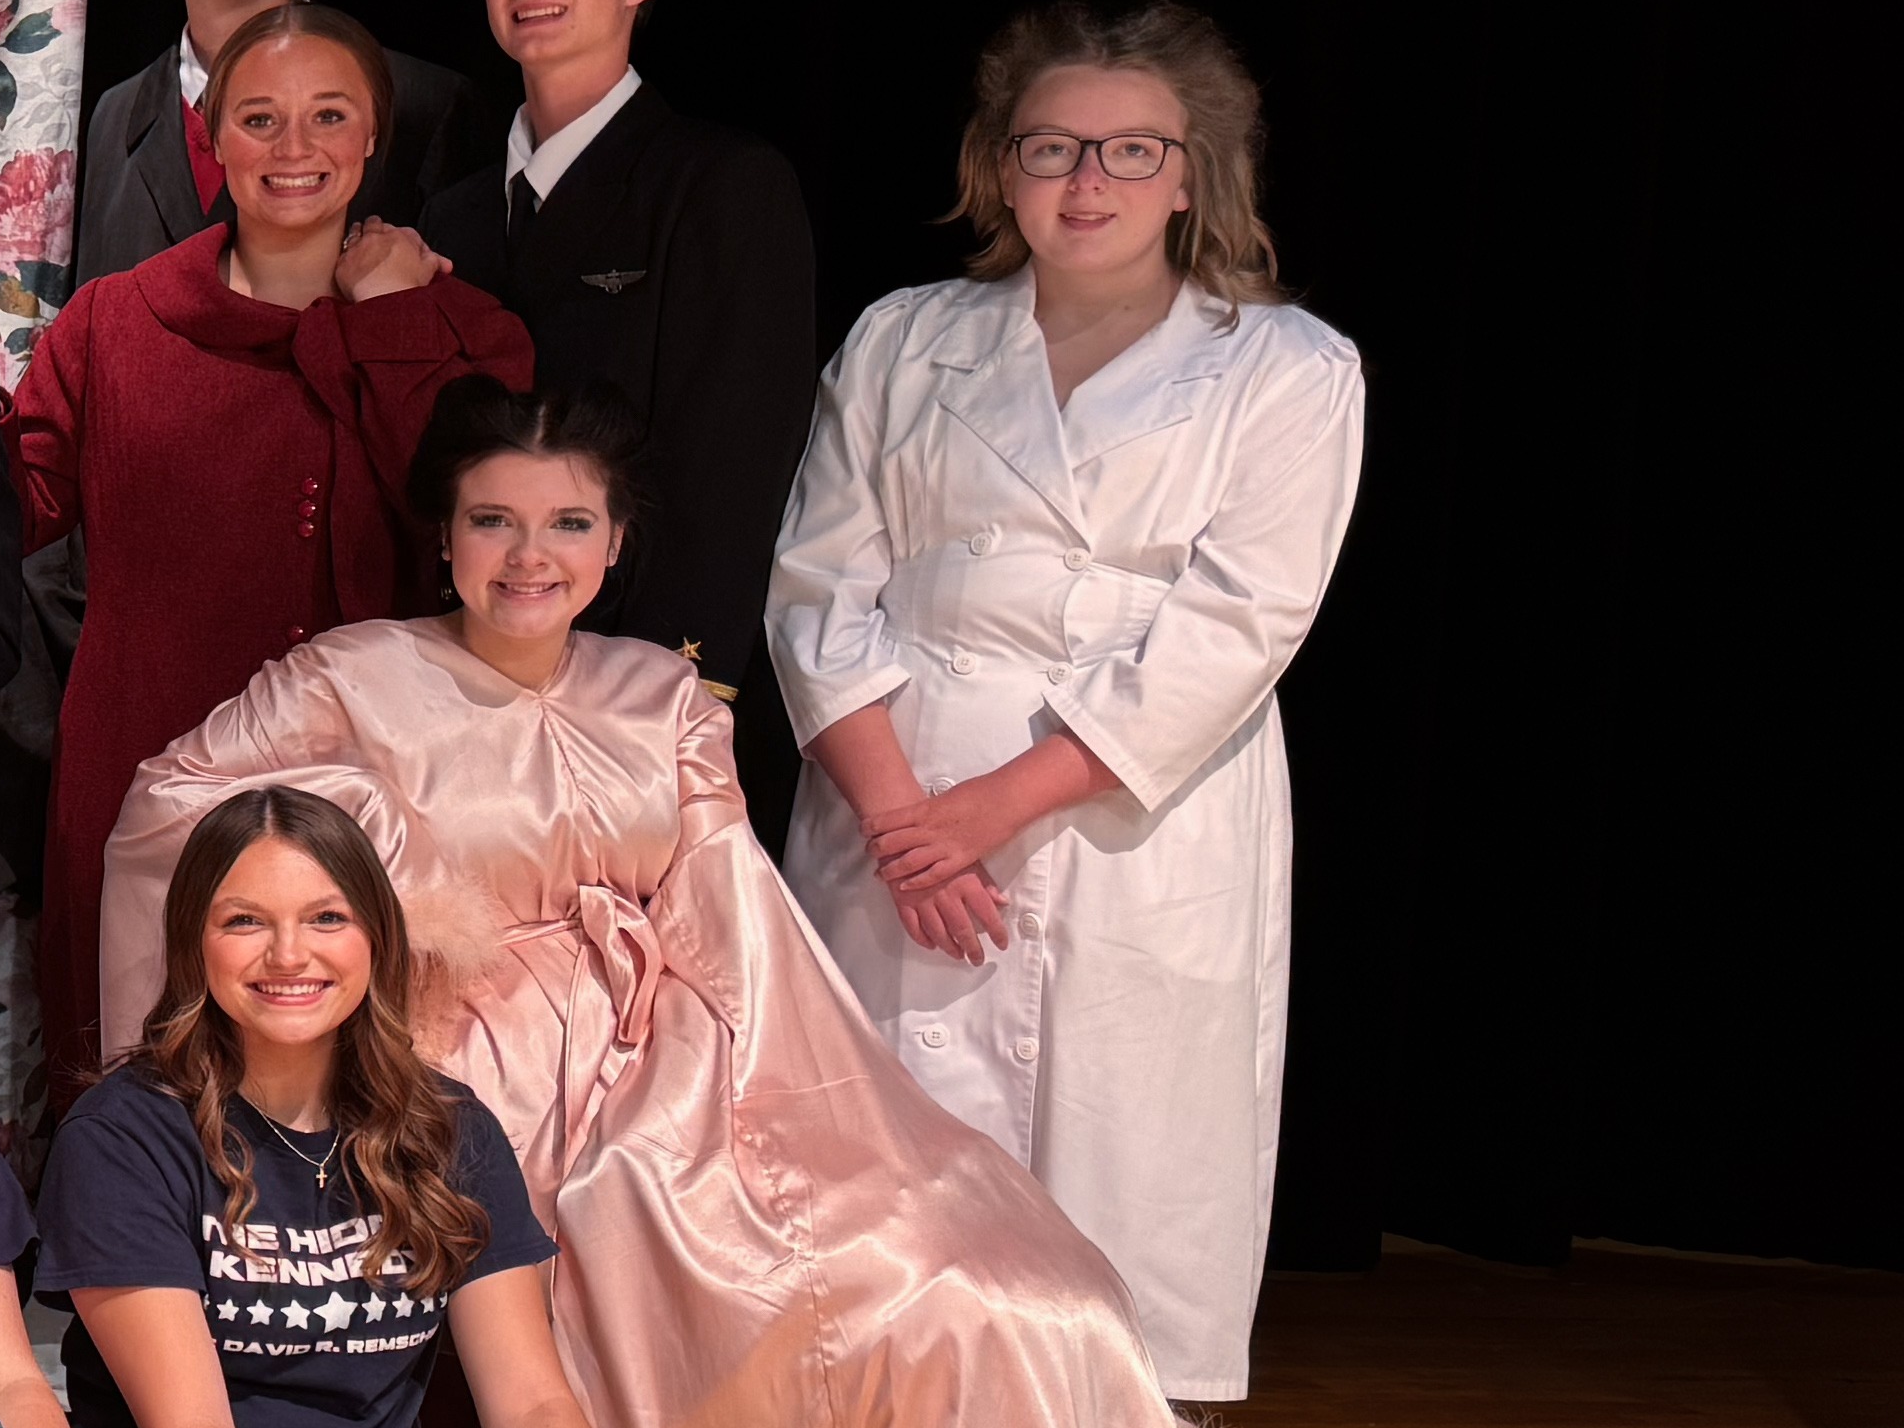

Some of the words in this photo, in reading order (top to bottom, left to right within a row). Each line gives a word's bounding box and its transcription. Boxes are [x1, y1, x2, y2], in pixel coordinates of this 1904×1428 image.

[285, 1214, 385, 1255] HID
[223, 1339, 311, 1357] DAVID
[315, 1340, 341, 1353] R.
[347, 1322, 440, 1354] REMSCH
